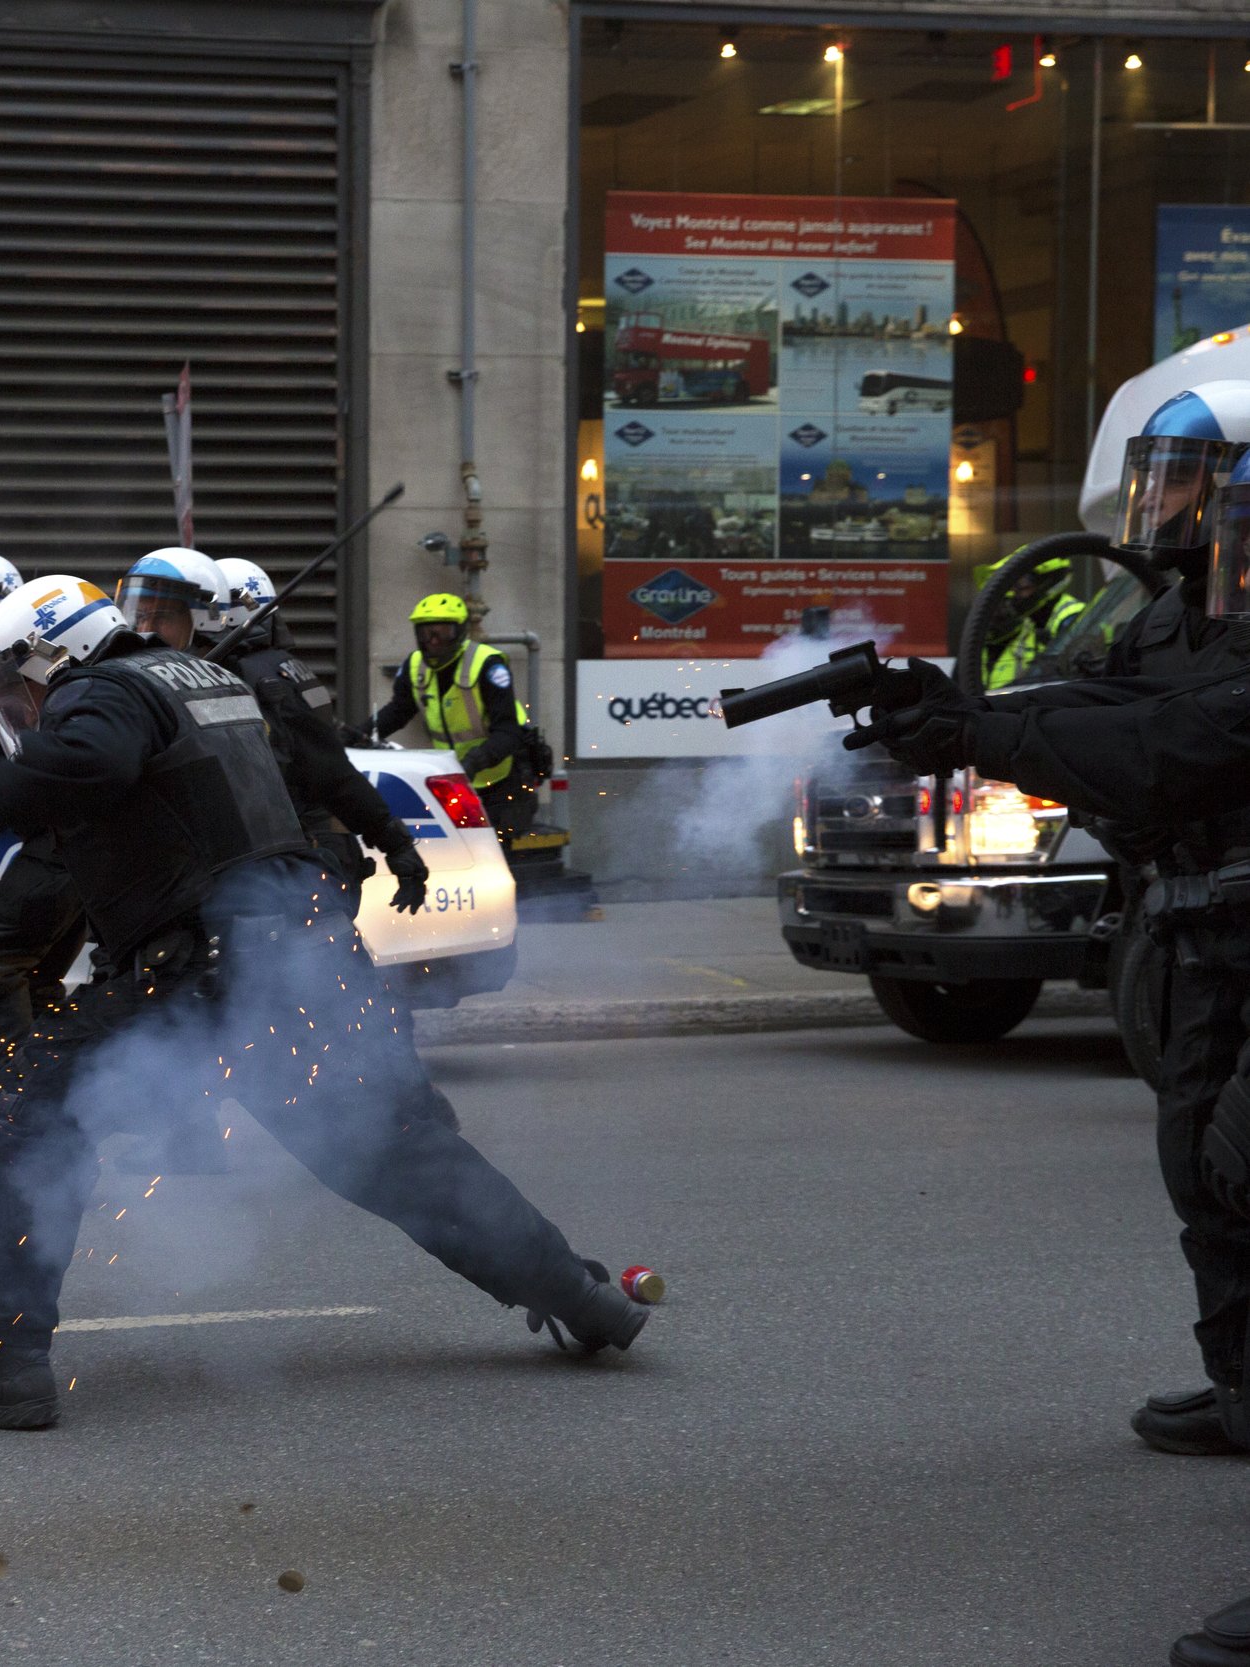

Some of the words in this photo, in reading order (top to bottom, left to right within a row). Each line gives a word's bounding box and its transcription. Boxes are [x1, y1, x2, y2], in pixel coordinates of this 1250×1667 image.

[630, 213, 672, 232] Voyez
[676, 214, 740, 231] Montréal
[743, 219, 796, 232] comme
[798, 218, 844, 235] jamais
[685, 236, 708, 249] See
[710, 236, 770, 250] Montreal
[771, 238, 794, 251] like
[720, 568, 757, 581] Tours
[760, 568, 806, 584] guidés
[817, 567, 875, 581] Services
[878, 568, 927, 581] nolisés
[42, 595, 68, 612] Police
[640, 626, 707, 639] Montréal
[148, 658, 244, 692] POLICE
[435, 886, 476, 913] 9-1-1
